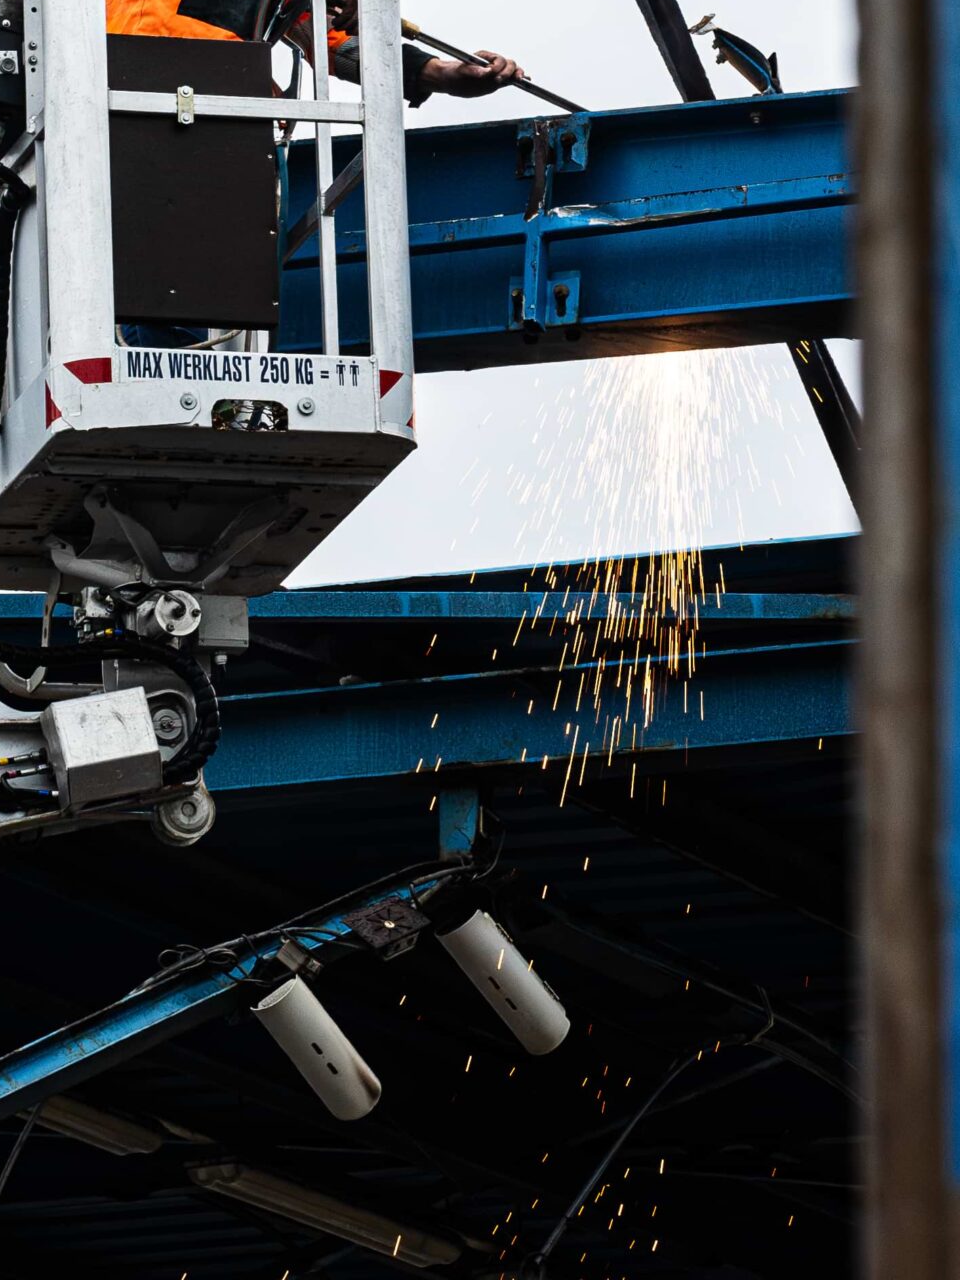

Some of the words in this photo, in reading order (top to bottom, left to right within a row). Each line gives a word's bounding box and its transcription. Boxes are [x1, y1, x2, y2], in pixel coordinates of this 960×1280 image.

[127, 351, 163, 379] MAX
[168, 352, 251, 383] WERKLAST
[259, 356, 290, 384] 250
[295, 358, 314, 385] KG
